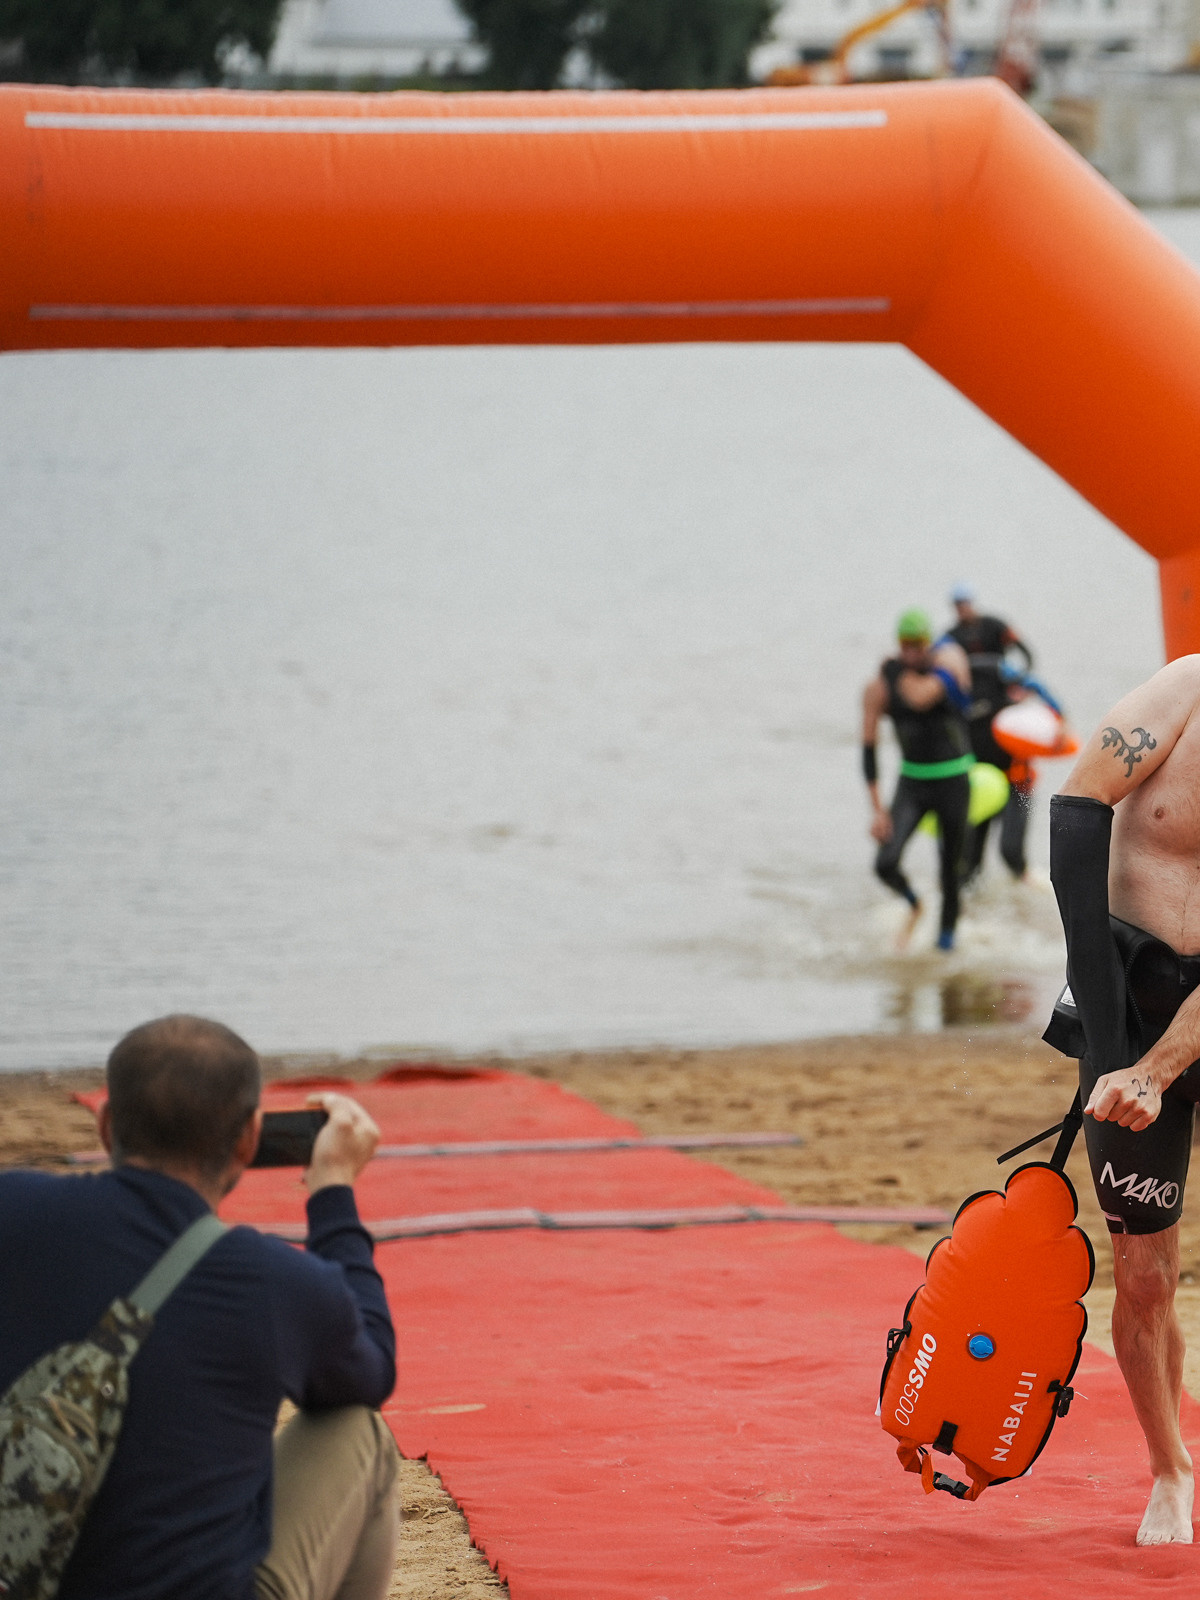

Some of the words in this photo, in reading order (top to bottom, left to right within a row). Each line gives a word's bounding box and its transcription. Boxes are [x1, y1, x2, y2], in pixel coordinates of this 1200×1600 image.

[1100, 1161, 1180, 1210] MAKO
[894, 1332, 937, 1426] OWS500
[990, 1371, 1038, 1462] NABAIJI
